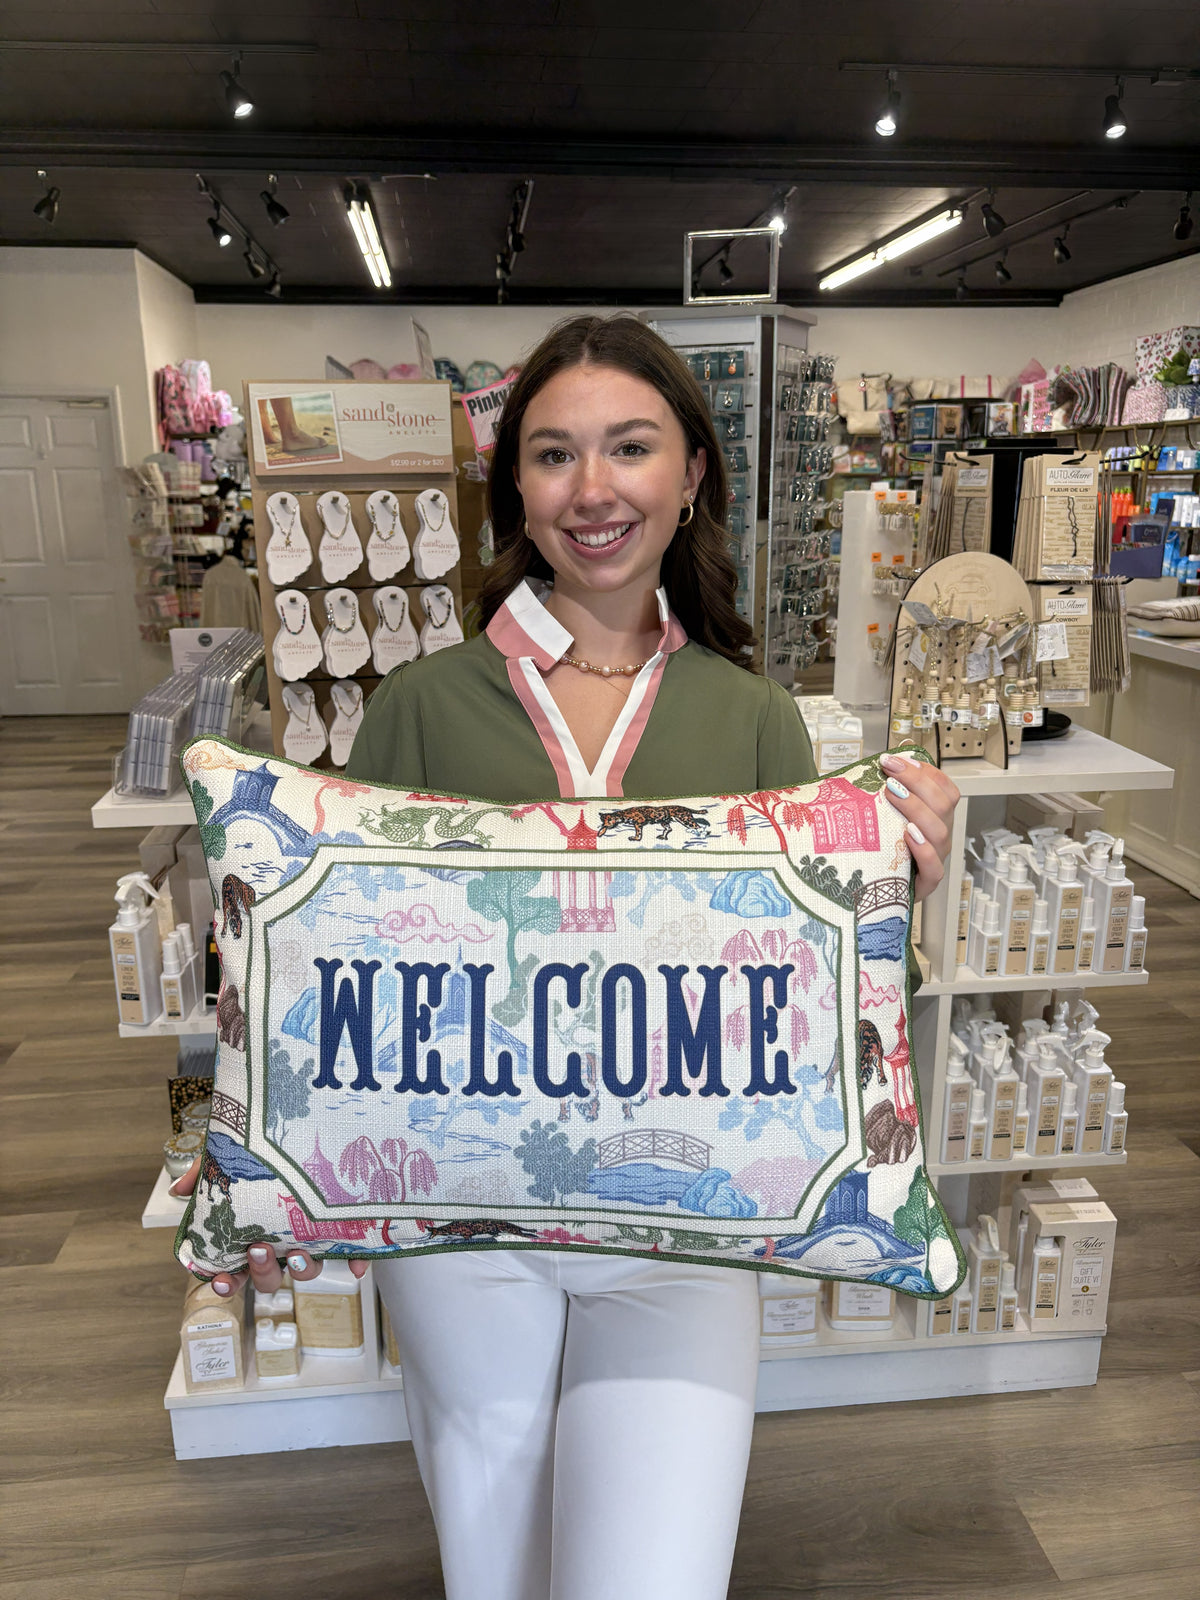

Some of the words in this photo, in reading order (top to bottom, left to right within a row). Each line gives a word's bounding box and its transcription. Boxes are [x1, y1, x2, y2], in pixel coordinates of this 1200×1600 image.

[342, 401, 385, 421] sand
[387, 411, 436, 427] stone
[312, 957, 798, 1098] WELCOME
[1073, 1237, 1105, 1253] Tyler
[1073, 1276, 1091, 1284] SUITE
[196, 1358, 229, 1373] Tyler
